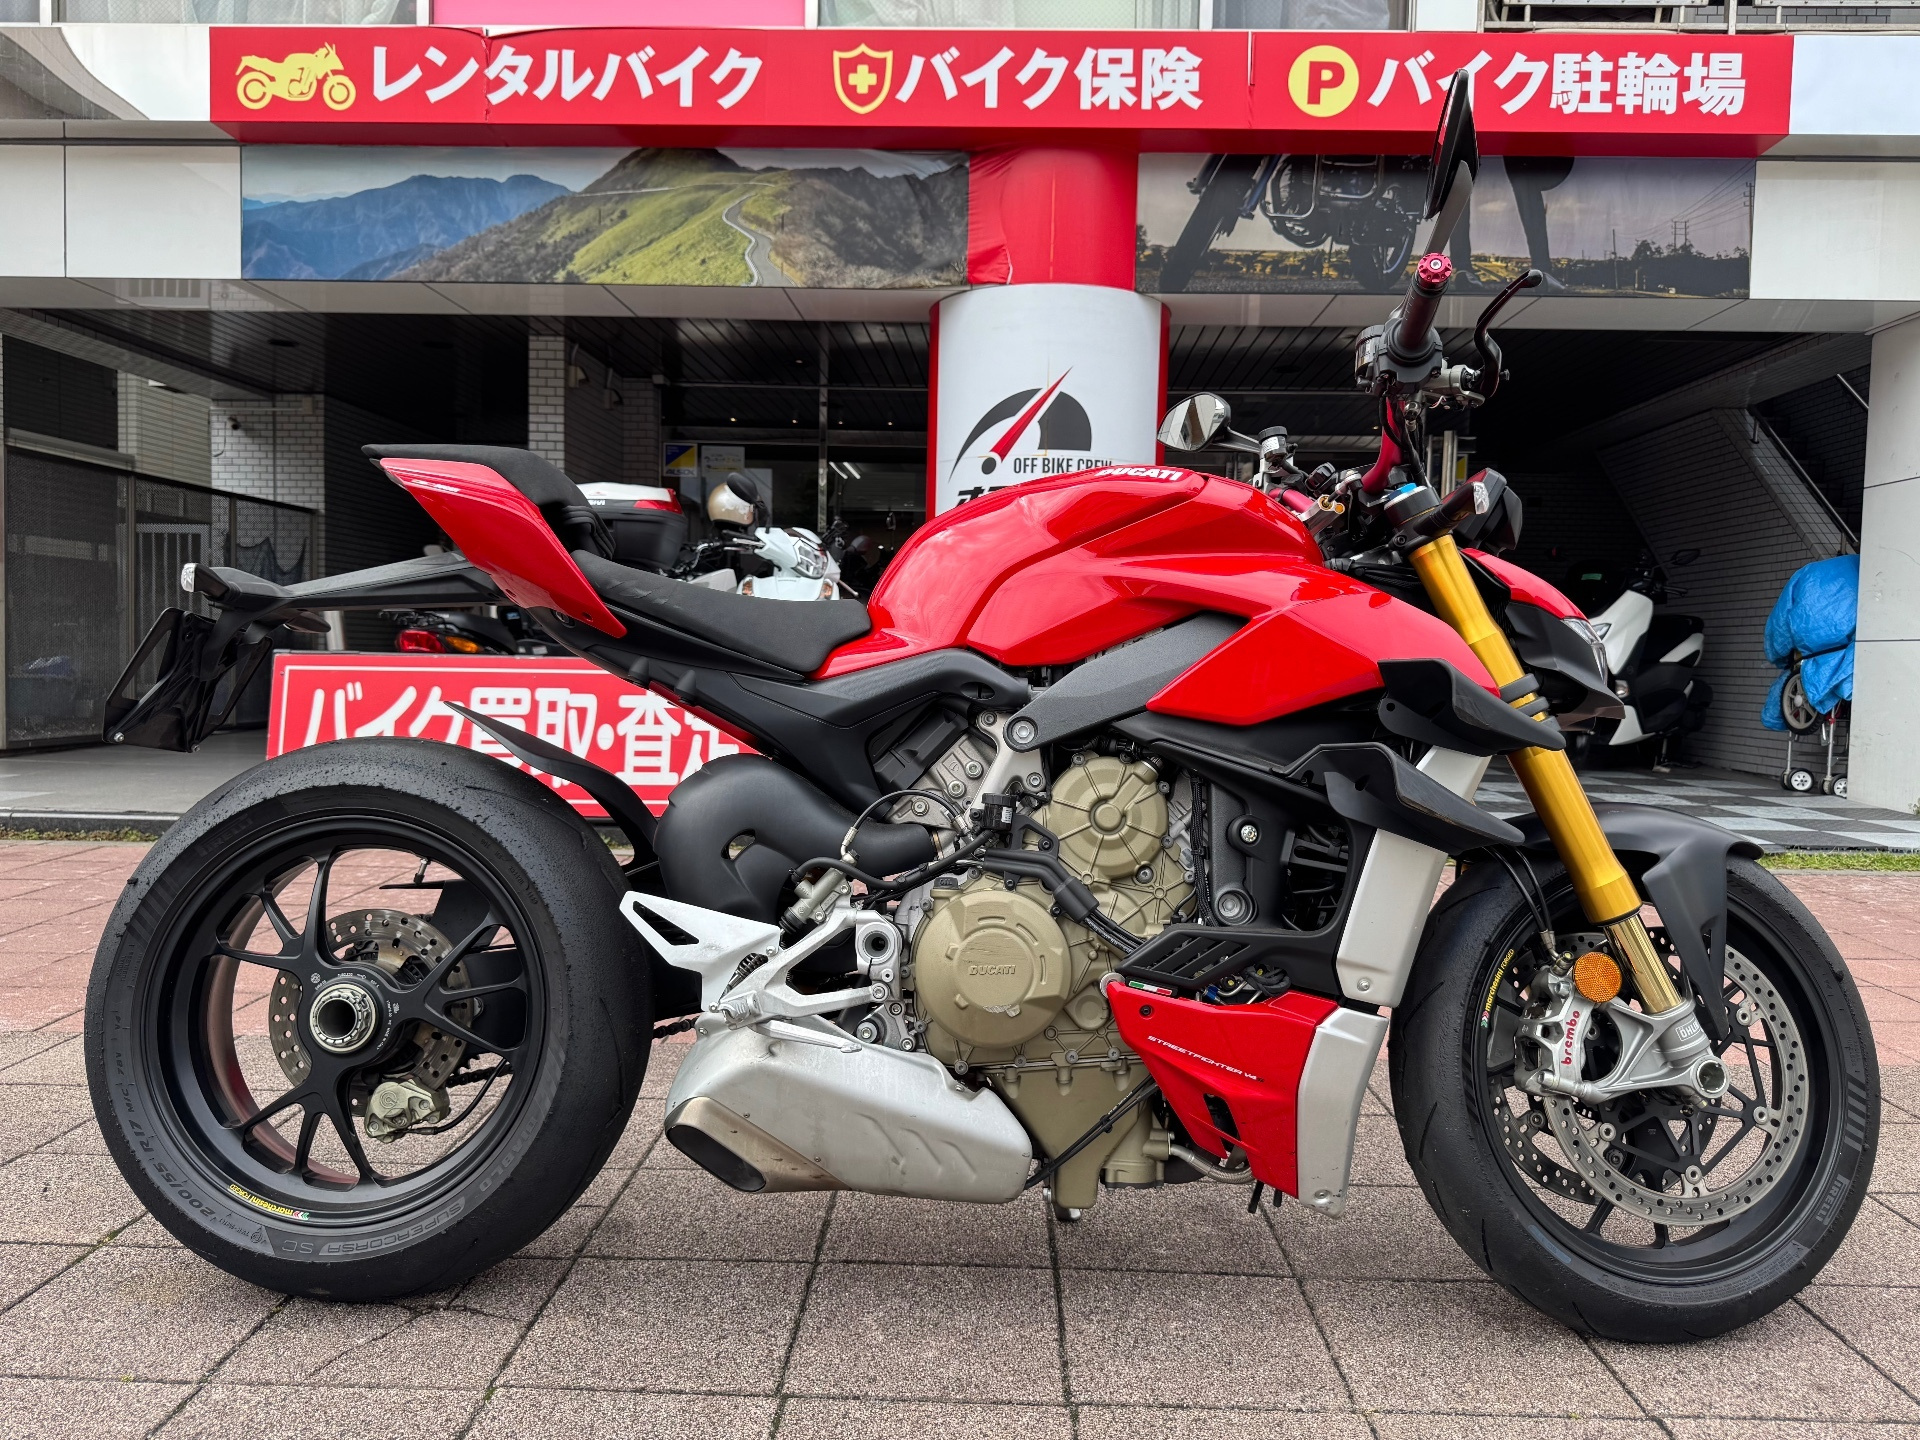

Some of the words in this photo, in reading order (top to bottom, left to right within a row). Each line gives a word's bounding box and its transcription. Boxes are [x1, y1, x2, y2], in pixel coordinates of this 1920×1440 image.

[371, 45, 763, 110] レンタルバイク
[895, 46, 1204, 110] バイク保険
[1306, 60, 1345, 105] P
[1367, 50, 1747, 116] バイク駐輪場
[1013, 457, 1038, 474] OFF
[1042, 458, 1073, 474] BIKE
[1094, 467, 1183, 481] DUCATI
[968, 964, 1016, 976] DUCATI
[1485, 968, 1503, 1012] marchesini
[1501, 948, 1515, 970] FORGED
[1147, 1035, 1243, 1075] STREETFIGHTER
[1561, 1010, 1581, 1066] brembo
[115, 1052, 124, 1076] 78V
[123, 1088, 135, 1113] M/C
[479, 1116, 540, 1192] DIABLO
[153, 1162, 216, 1218] 200/55
[229, 1183, 251, 1201] FORGED
[249, 1195, 294, 1216] marchesini
[1816, 1173, 1851, 1226] PIRELLI
[281, 1239, 314, 1254] SC
[327, 1203, 463, 1254] SUPERCORSA
